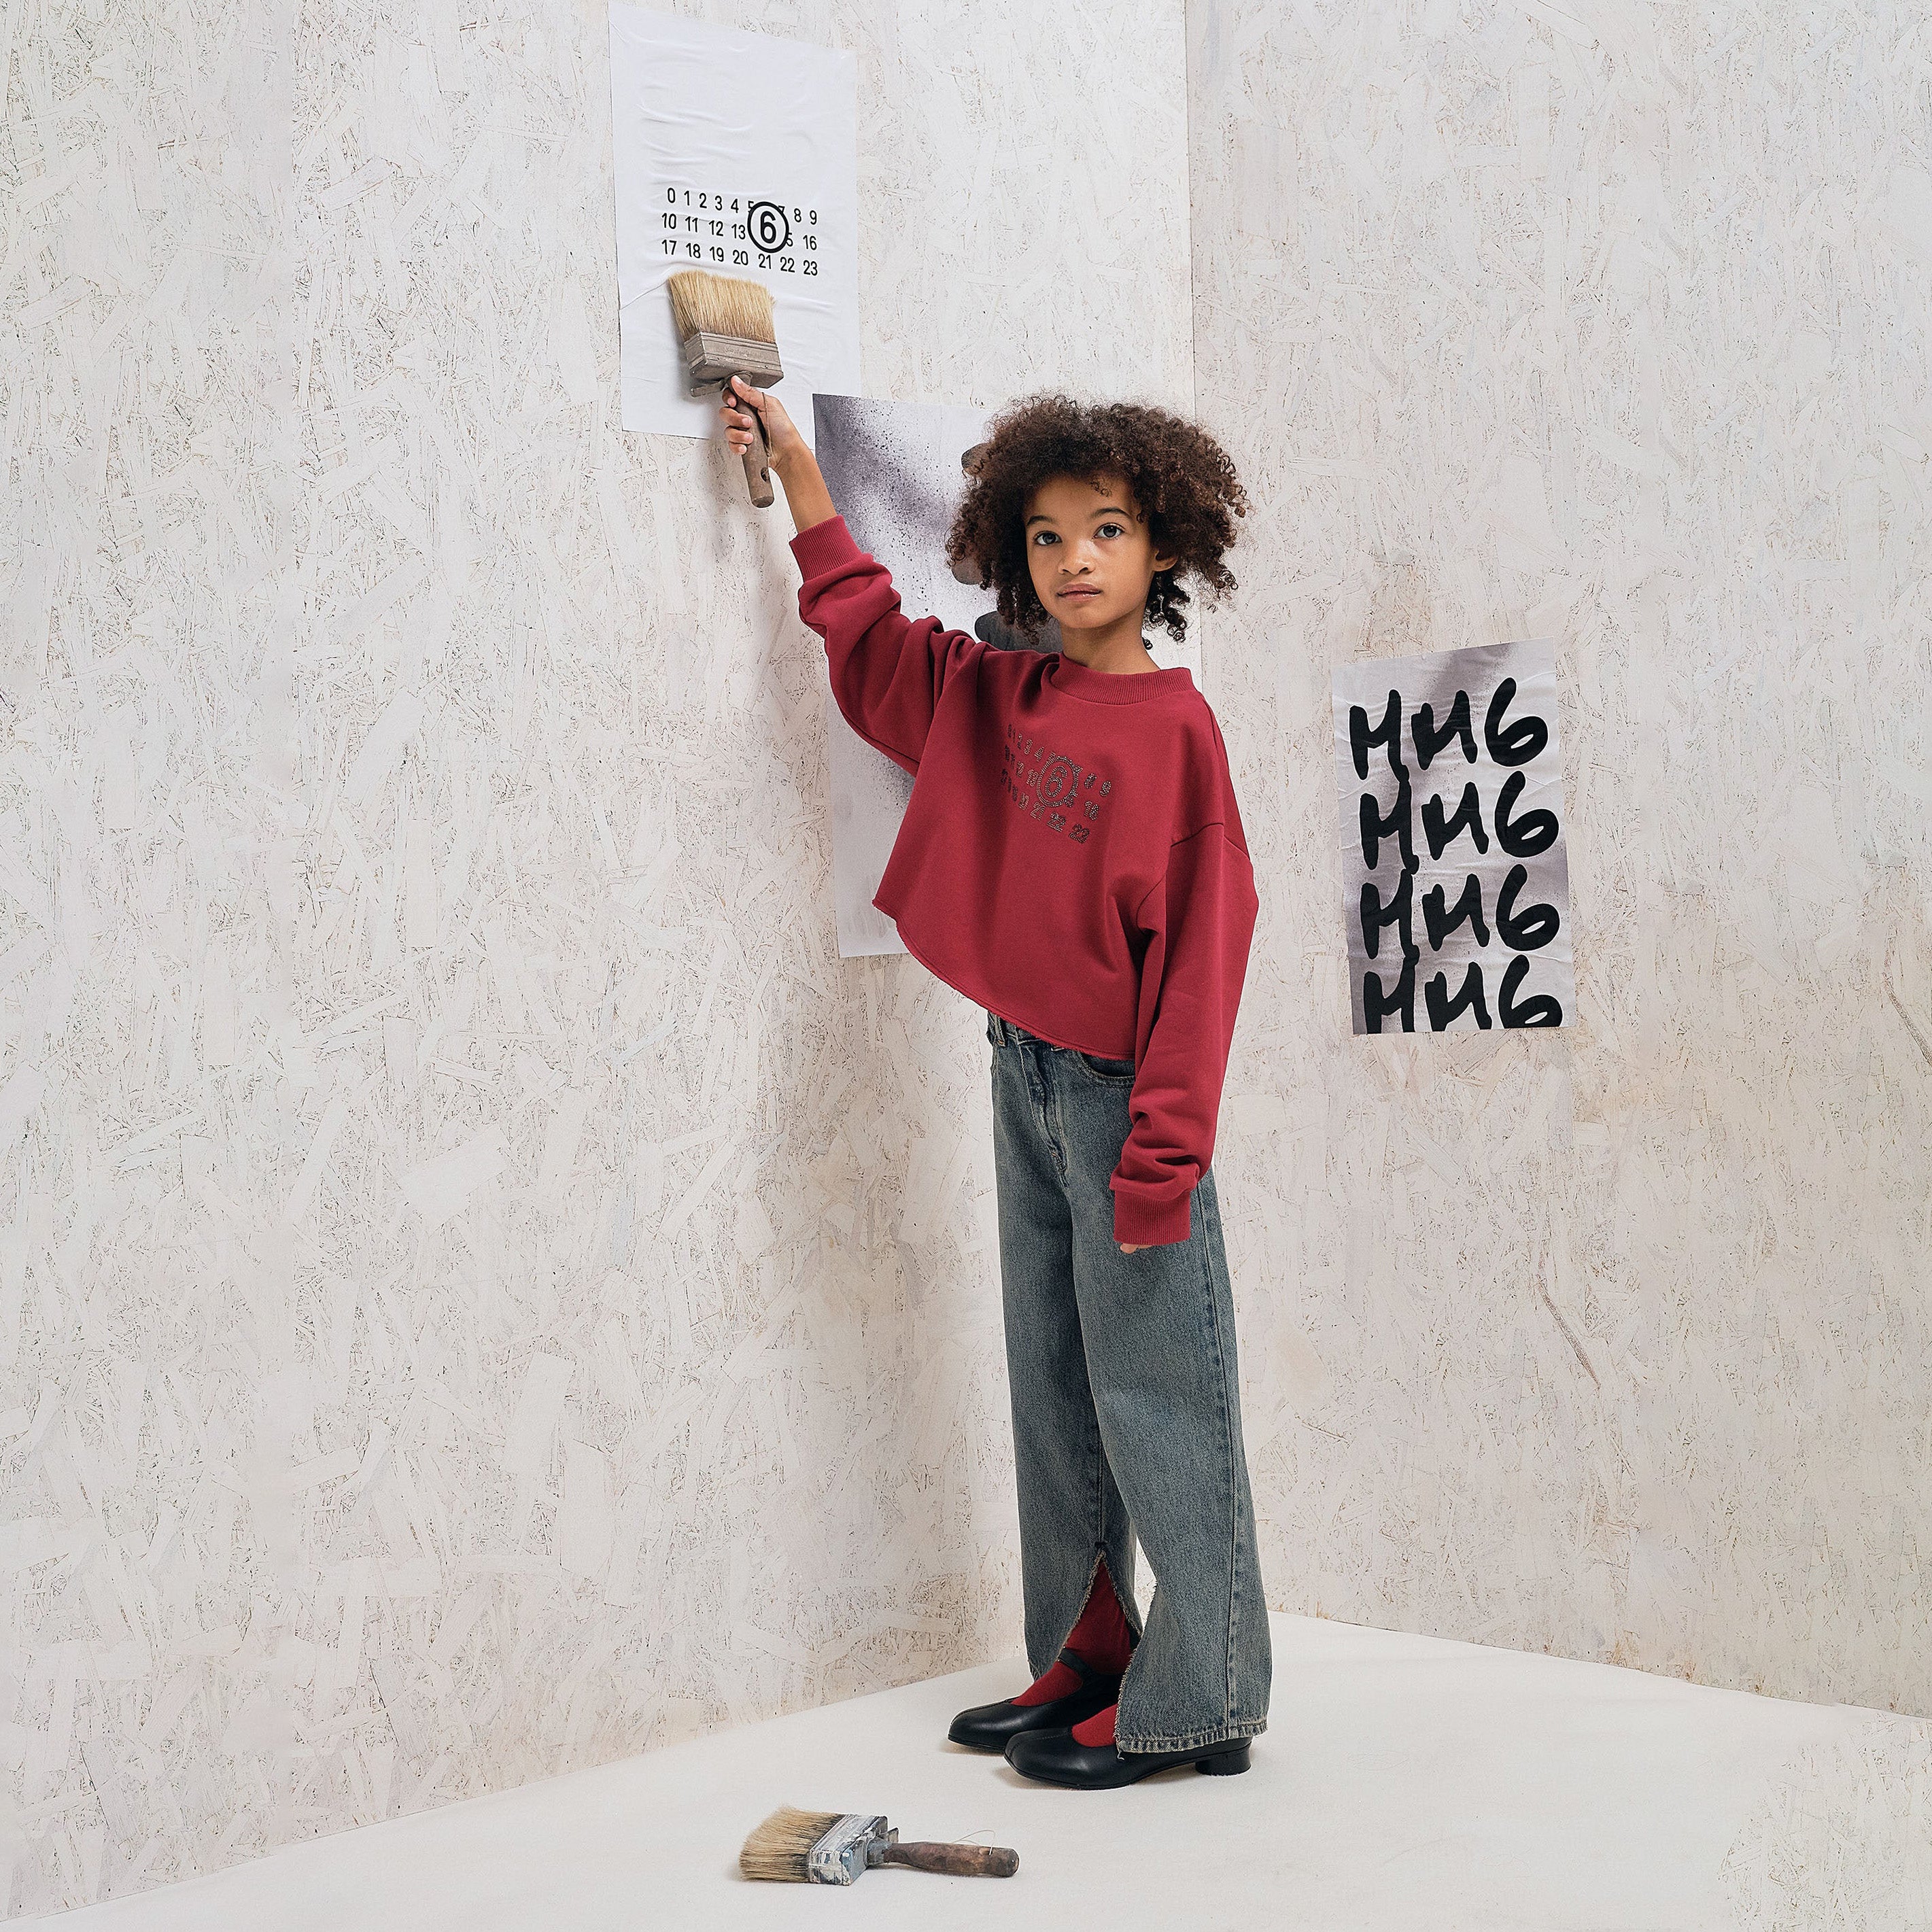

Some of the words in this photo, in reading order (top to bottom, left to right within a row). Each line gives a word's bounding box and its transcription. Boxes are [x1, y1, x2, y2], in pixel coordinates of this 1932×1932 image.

[661, 212, 677, 230] 10
[685, 215, 699, 233] 11
[708, 220, 724, 237] 12
[731, 223, 746, 240] 13
[802, 235, 817, 251] 16
[667, 187, 676, 204] 0
[683, 190, 690, 206] 1
[699, 192, 708, 209] 2
[714, 195, 723, 211] 3
[730, 198, 739, 213] 4
[760, 210, 777, 244] 6
[793, 207, 802, 223] 8
[809, 209, 817, 226] 9
[661, 239, 677, 256] 17
[685, 242, 701, 259] 18
[709, 245, 724, 262] 19
[732, 249, 748, 266] 20
[758, 253, 772, 270] 21
[780, 256, 795, 273] 22
[803, 260, 818, 277] 23
[1045, 765, 1068, 798] 6
[1099, 780, 1111, 797] 9
[1047, 812, 1067, 833] 22
[1084, 801, 1099, 821] 16
